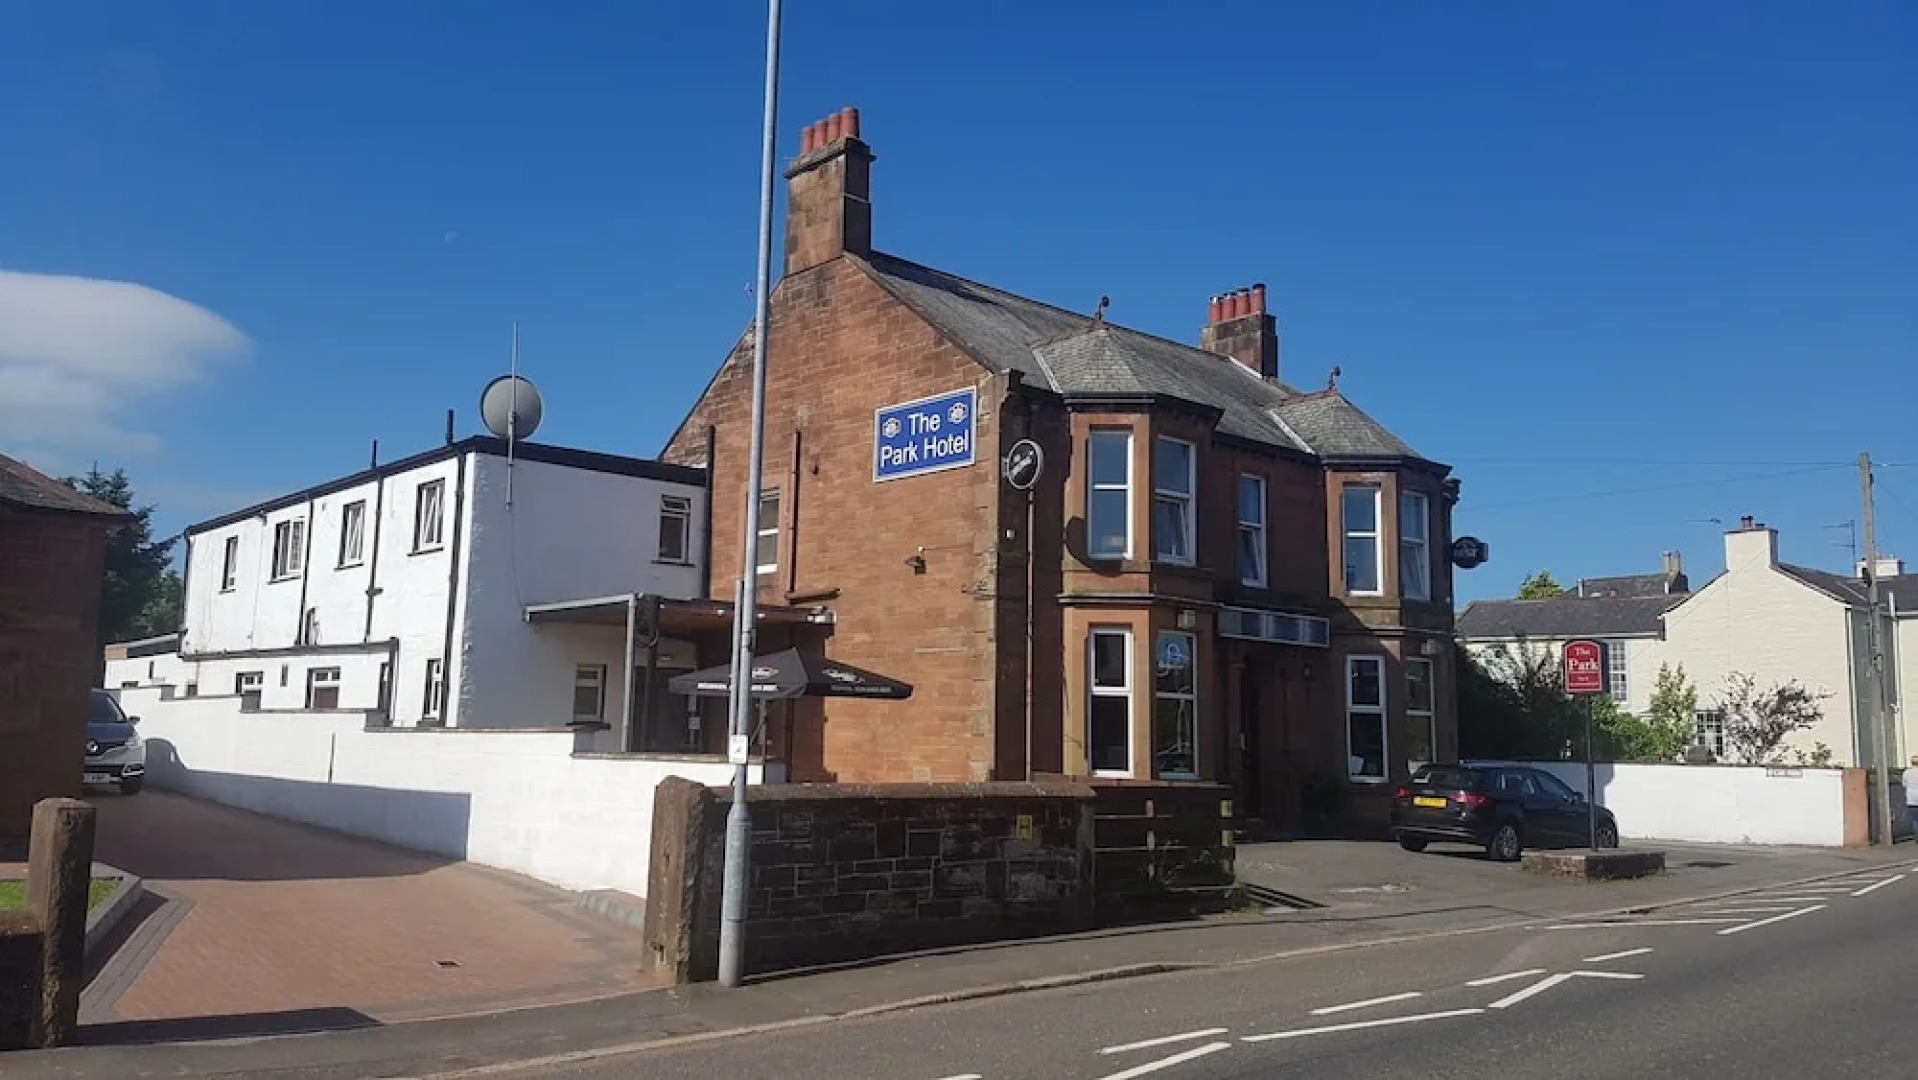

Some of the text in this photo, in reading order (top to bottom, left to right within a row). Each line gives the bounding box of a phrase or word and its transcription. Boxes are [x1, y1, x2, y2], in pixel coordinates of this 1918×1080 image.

[908, 412, 941, 436] The
[880, 429, 970, 469] Park Hotel
[1568, 657, 1598, 670] Park
